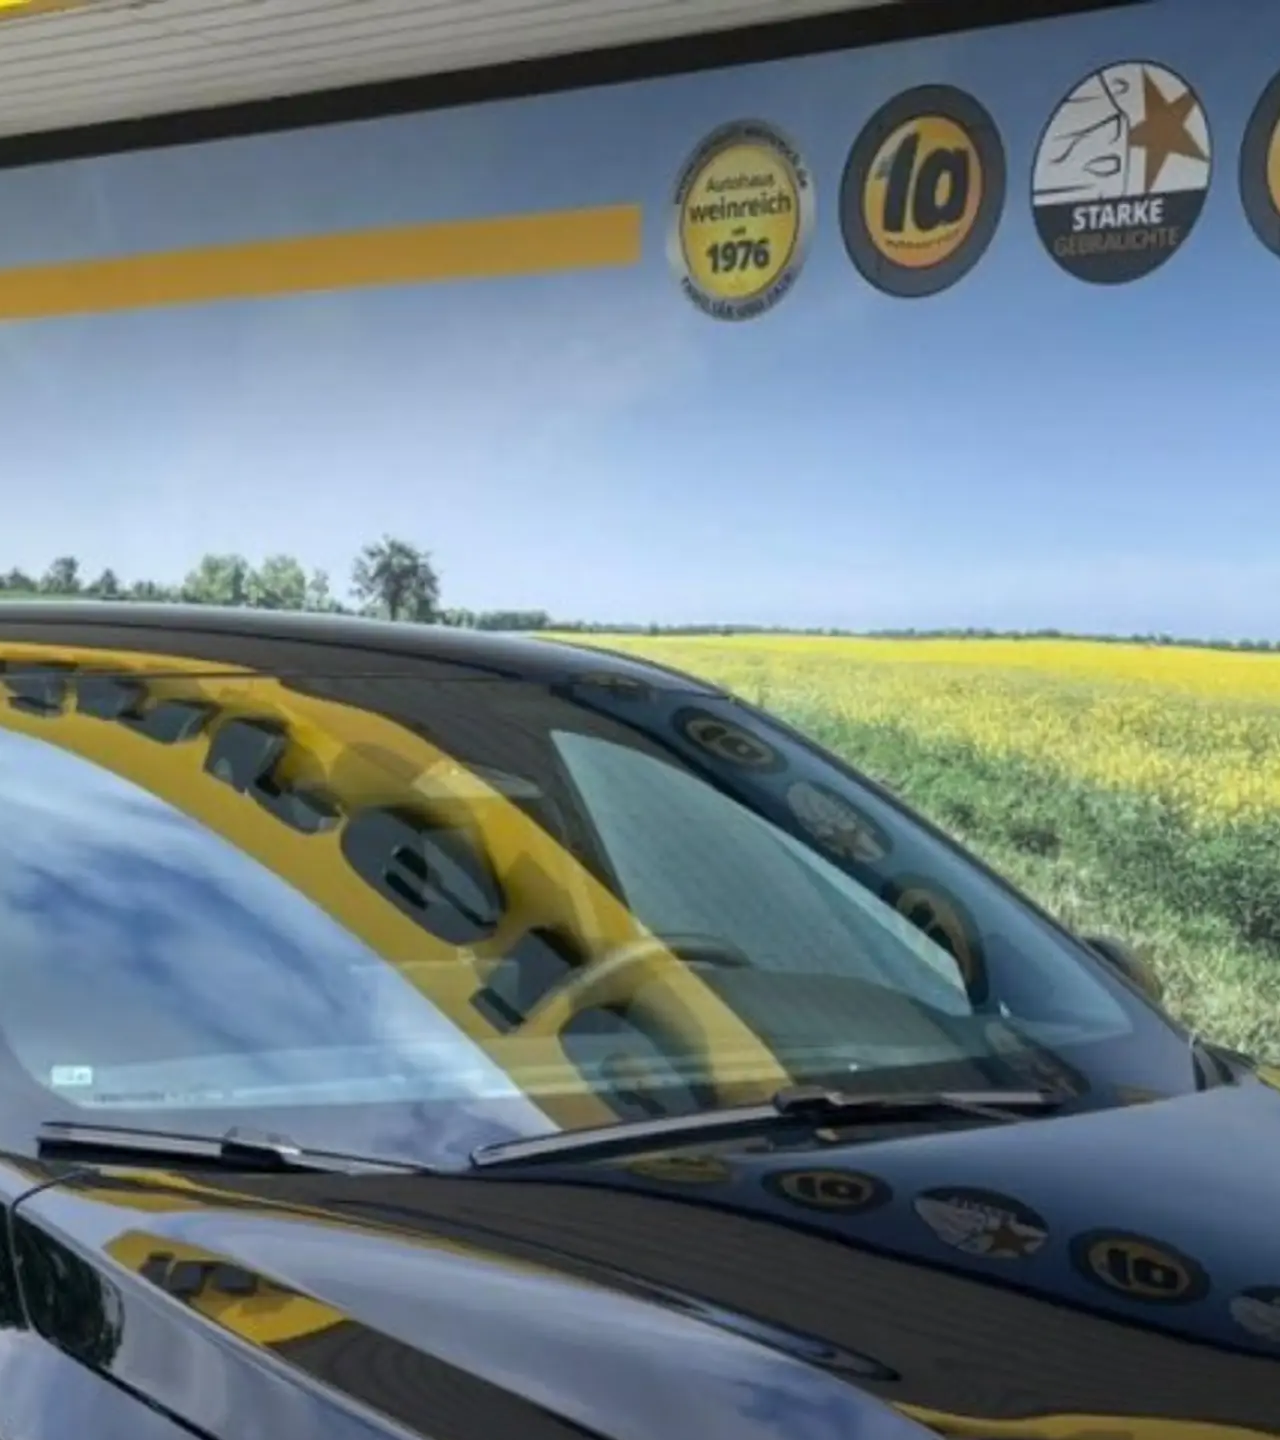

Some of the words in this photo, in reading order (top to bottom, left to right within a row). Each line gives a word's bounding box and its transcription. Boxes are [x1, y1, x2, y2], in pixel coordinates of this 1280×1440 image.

[689, 191, 792, 225] weinreich
[1072, 198, 1164, 232] STARKE
[706, 238, 771, 275] 1976
